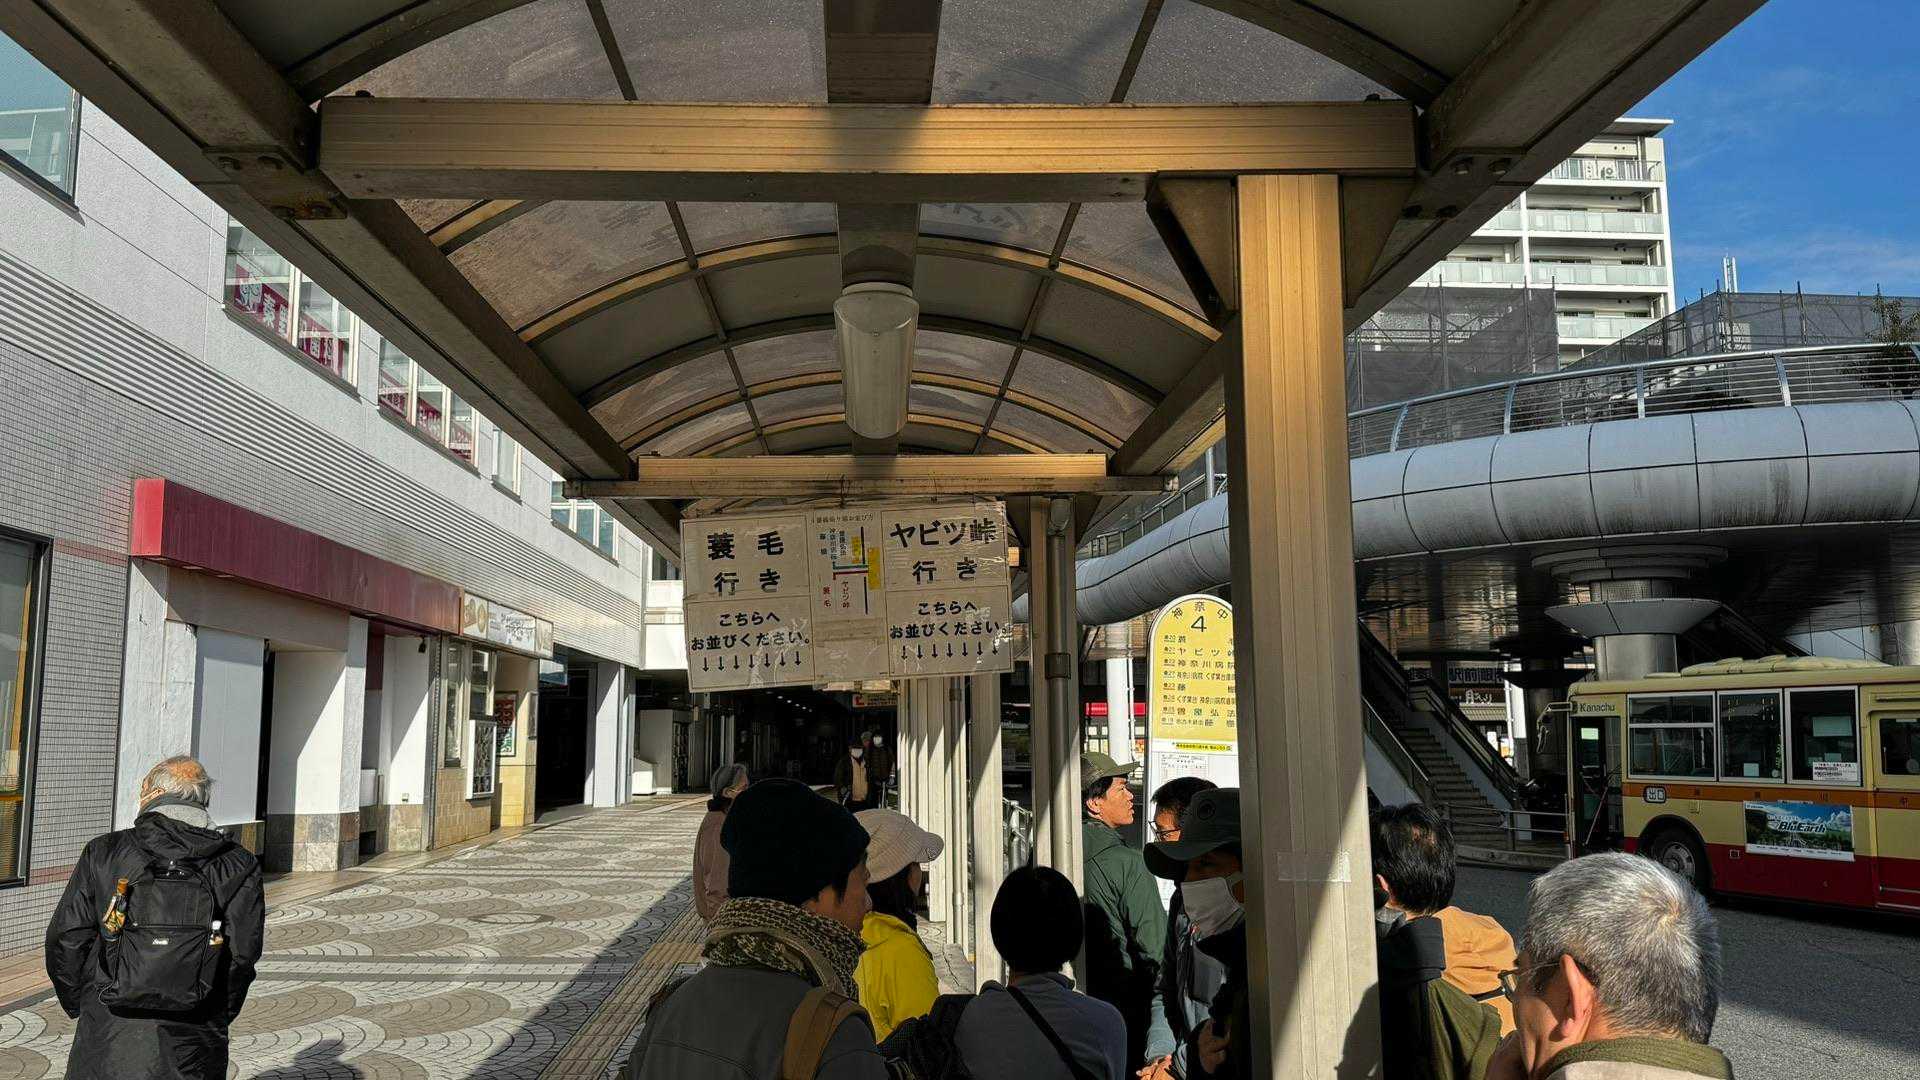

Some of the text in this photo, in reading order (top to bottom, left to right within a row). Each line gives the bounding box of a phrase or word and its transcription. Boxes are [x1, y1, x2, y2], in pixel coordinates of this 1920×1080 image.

[890, 517, 997, 548] ヤビツ峠
[912, 556, 978, 585] 行き
[714, 568, 781, 597] 行き
[918, 600, 978, 616] こちらへ
[720, 611, 781, 627] こちらへ
[1191, 615, 1208, 632] 4
[890, 620, 1007, 639] お並びください。
[691, 631, 810, 651] お並びください。
[1579, 703, 1615, 713] Kanachu
[1648, 788, 1665, 801] 出口
[1778, 820, 1826, 834] BluEarth
